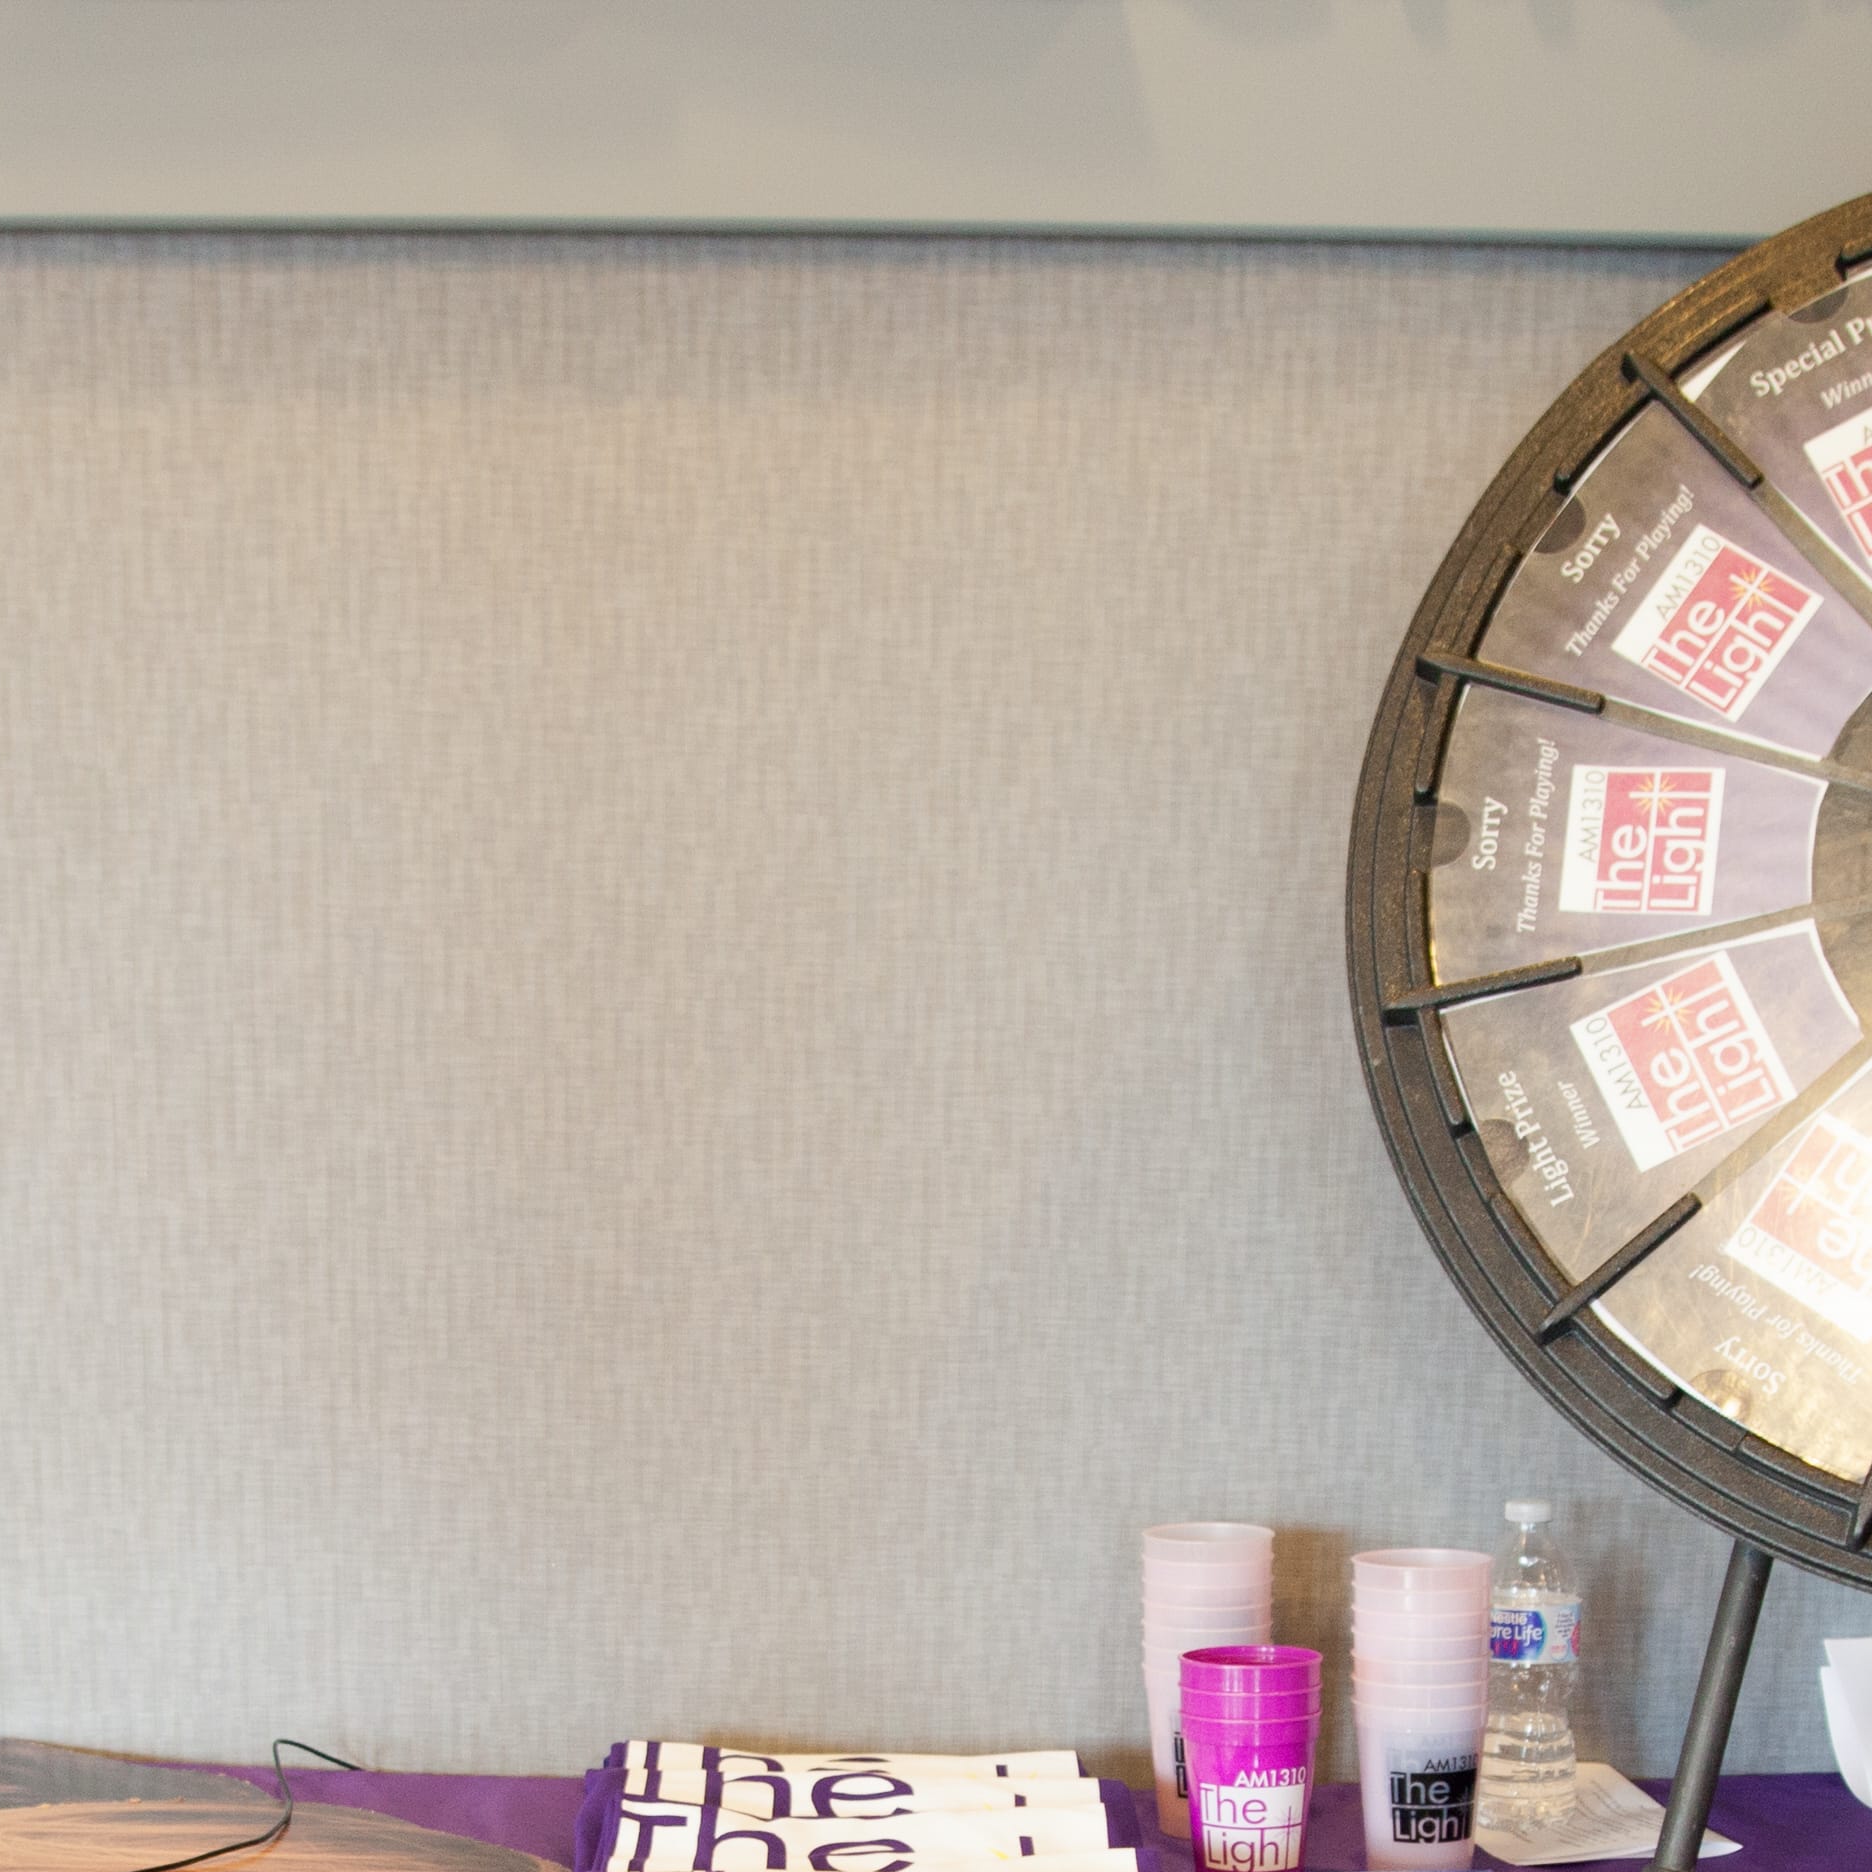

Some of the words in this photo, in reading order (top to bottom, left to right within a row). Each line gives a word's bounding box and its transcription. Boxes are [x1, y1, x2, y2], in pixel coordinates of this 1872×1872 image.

[1750, 330, 1846, 397] Special
[1561, 514, 1620, 582] Sorry
[1566, 592, 1619, 656] Thanks
[1612, 560, 1644, 594] For
[1636, 484, 1695, 562] Playing!
[1656, 536, 1720, 621] AM1310
[1646, 600, 1724, 680] The
[1689, 574, 1799, 706] Light
[1529, 738, 1558, 820] Playing!
[1472, 797, 1508, 870] Sorry
[1524, 823, 1545, 858] For
[1580, 771, 1605, 862] AM1310
[1629, 792, 1712, 908] Light
[1518, 868, 1542, 932] Thanks
[1597, 824, 1647, 909] The
[1586, 1017, 1649, 1110] AM1310
[1641, 982, 1776, 1123] Light
[1498, 1071, 1540, 1140] Prize
[1557, 1080, 1600, 1149] Winner
[1650, 1048, 1718, 1147] The
[1528, 1137, 1573, 1207] Light
[1688, 1264, 1766, 1321] Playing!
[1714, 1336, 1786, 1394] Sorry
[1514, 1625, 1543, 1647] Life
[1200, 1784, 1267, 1825] The
[1234, 1766, 1306, 1787] AM1310
[1390, 1772, 1451, 1804] The
[1205, 1807, 1291, 1872] Light
